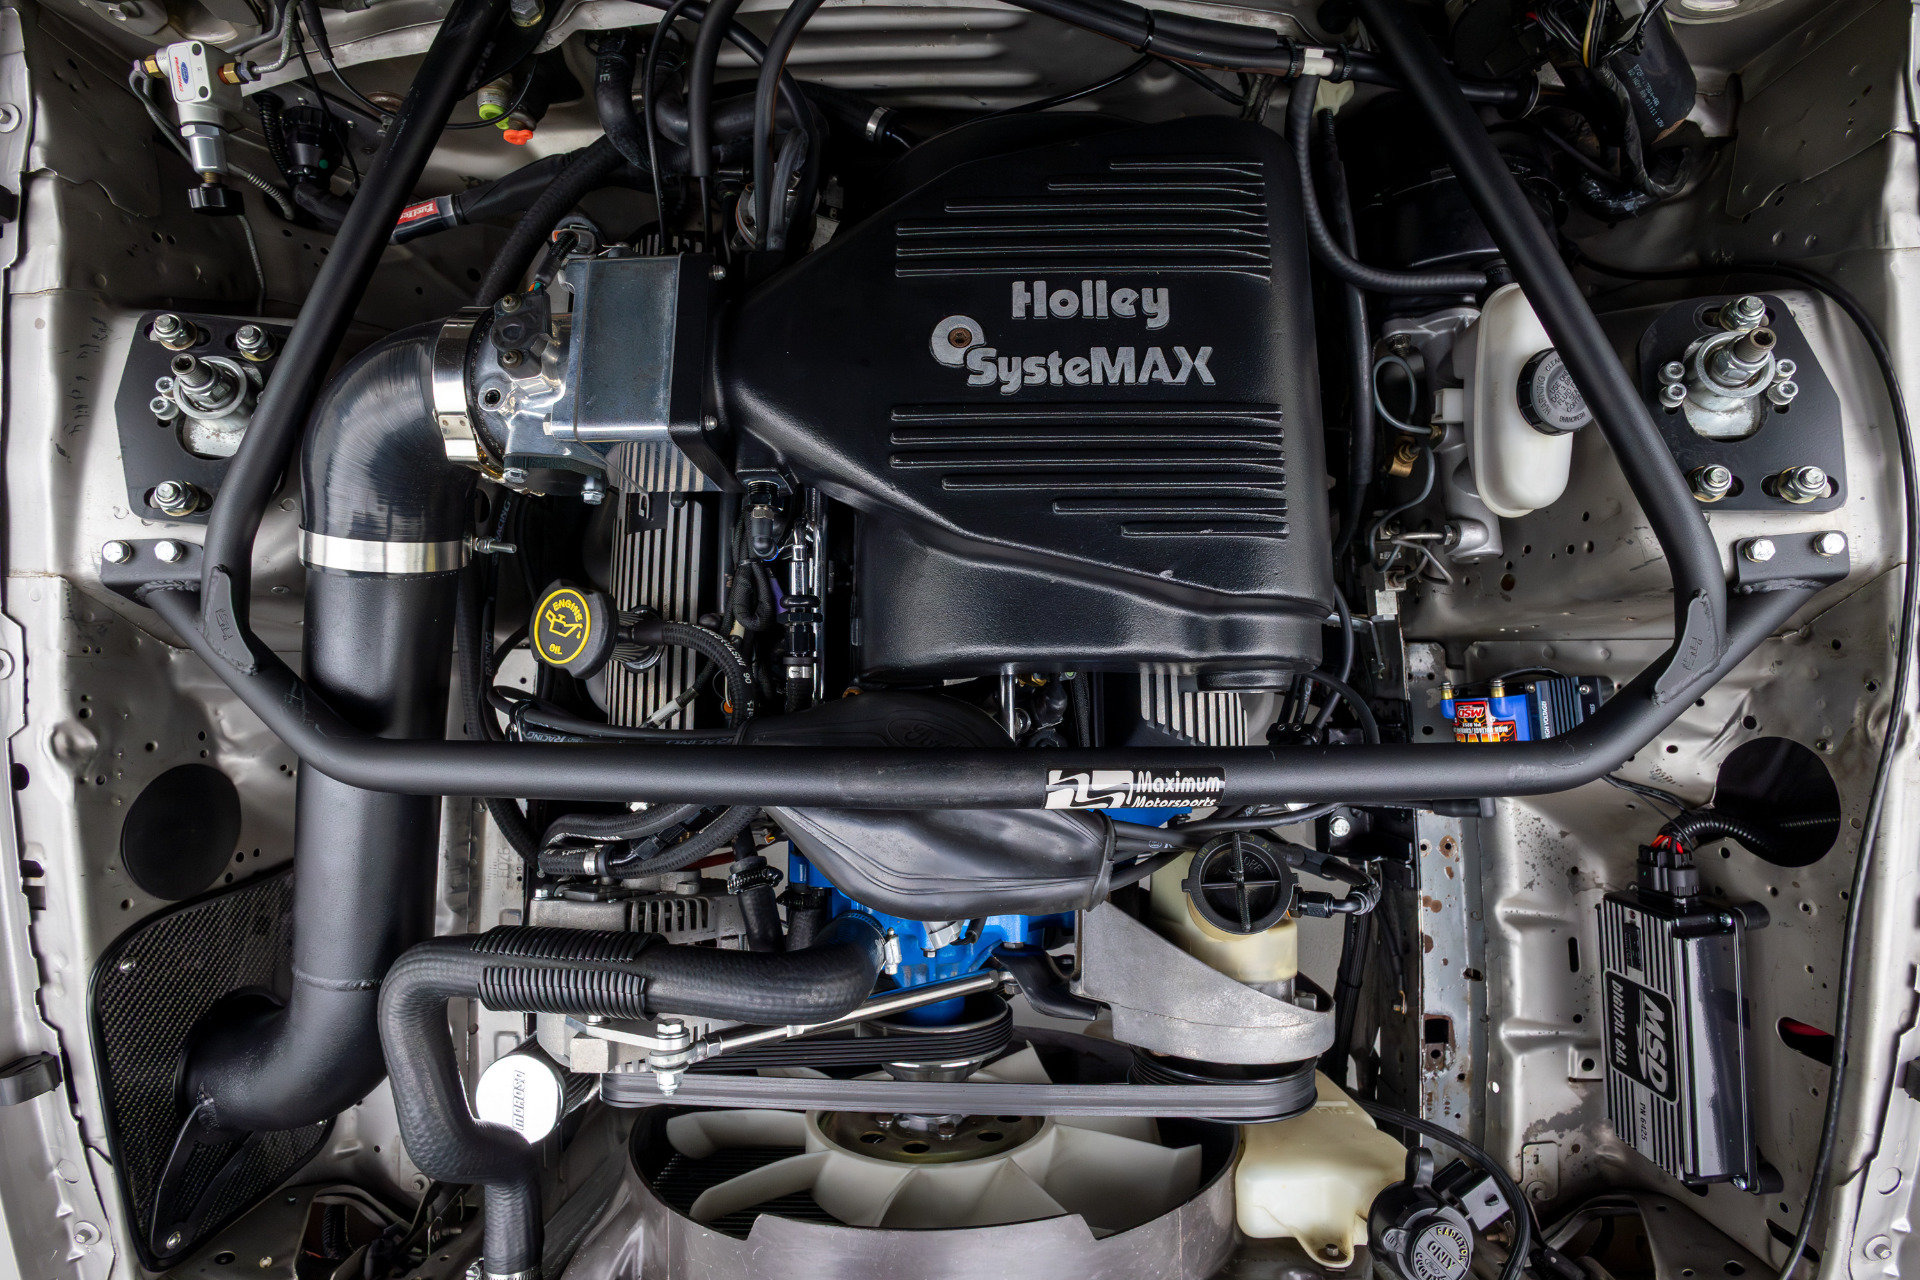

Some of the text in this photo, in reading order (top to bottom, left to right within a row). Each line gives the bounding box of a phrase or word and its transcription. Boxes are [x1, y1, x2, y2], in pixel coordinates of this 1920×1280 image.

[399, 203, 434, 220] FuelTec
[1011, 280, 1170, 331] Holley
[967, 346, 1215, 395] SysteMAX
[1536, 357, 1562, 416] WARNING CLEA
[1549, 381, 1561, 394] USE
[1557, 388, 1572, 406] FLUID
[552, 598, 583, 622] ENGINE
[549, 643, 563, 655] OIL
[1457, 708, 1482, 718] MSD
[1136, 769, 1220, 793] Maximum
[1132, 795, 1217, 808] Motorsports
[1611, 979, 1628, 1066] DIGITAL 6AL
[1643, 994, 1668, 1093] MSD
[512, 1069, 525, 1130] MOROSO
[1639, 1102, 1648, 1142] PN 6425
[1427, 1240, 1456, 1270] ONLY
[1435, 1226, 1468, 1263] RADIATOR
